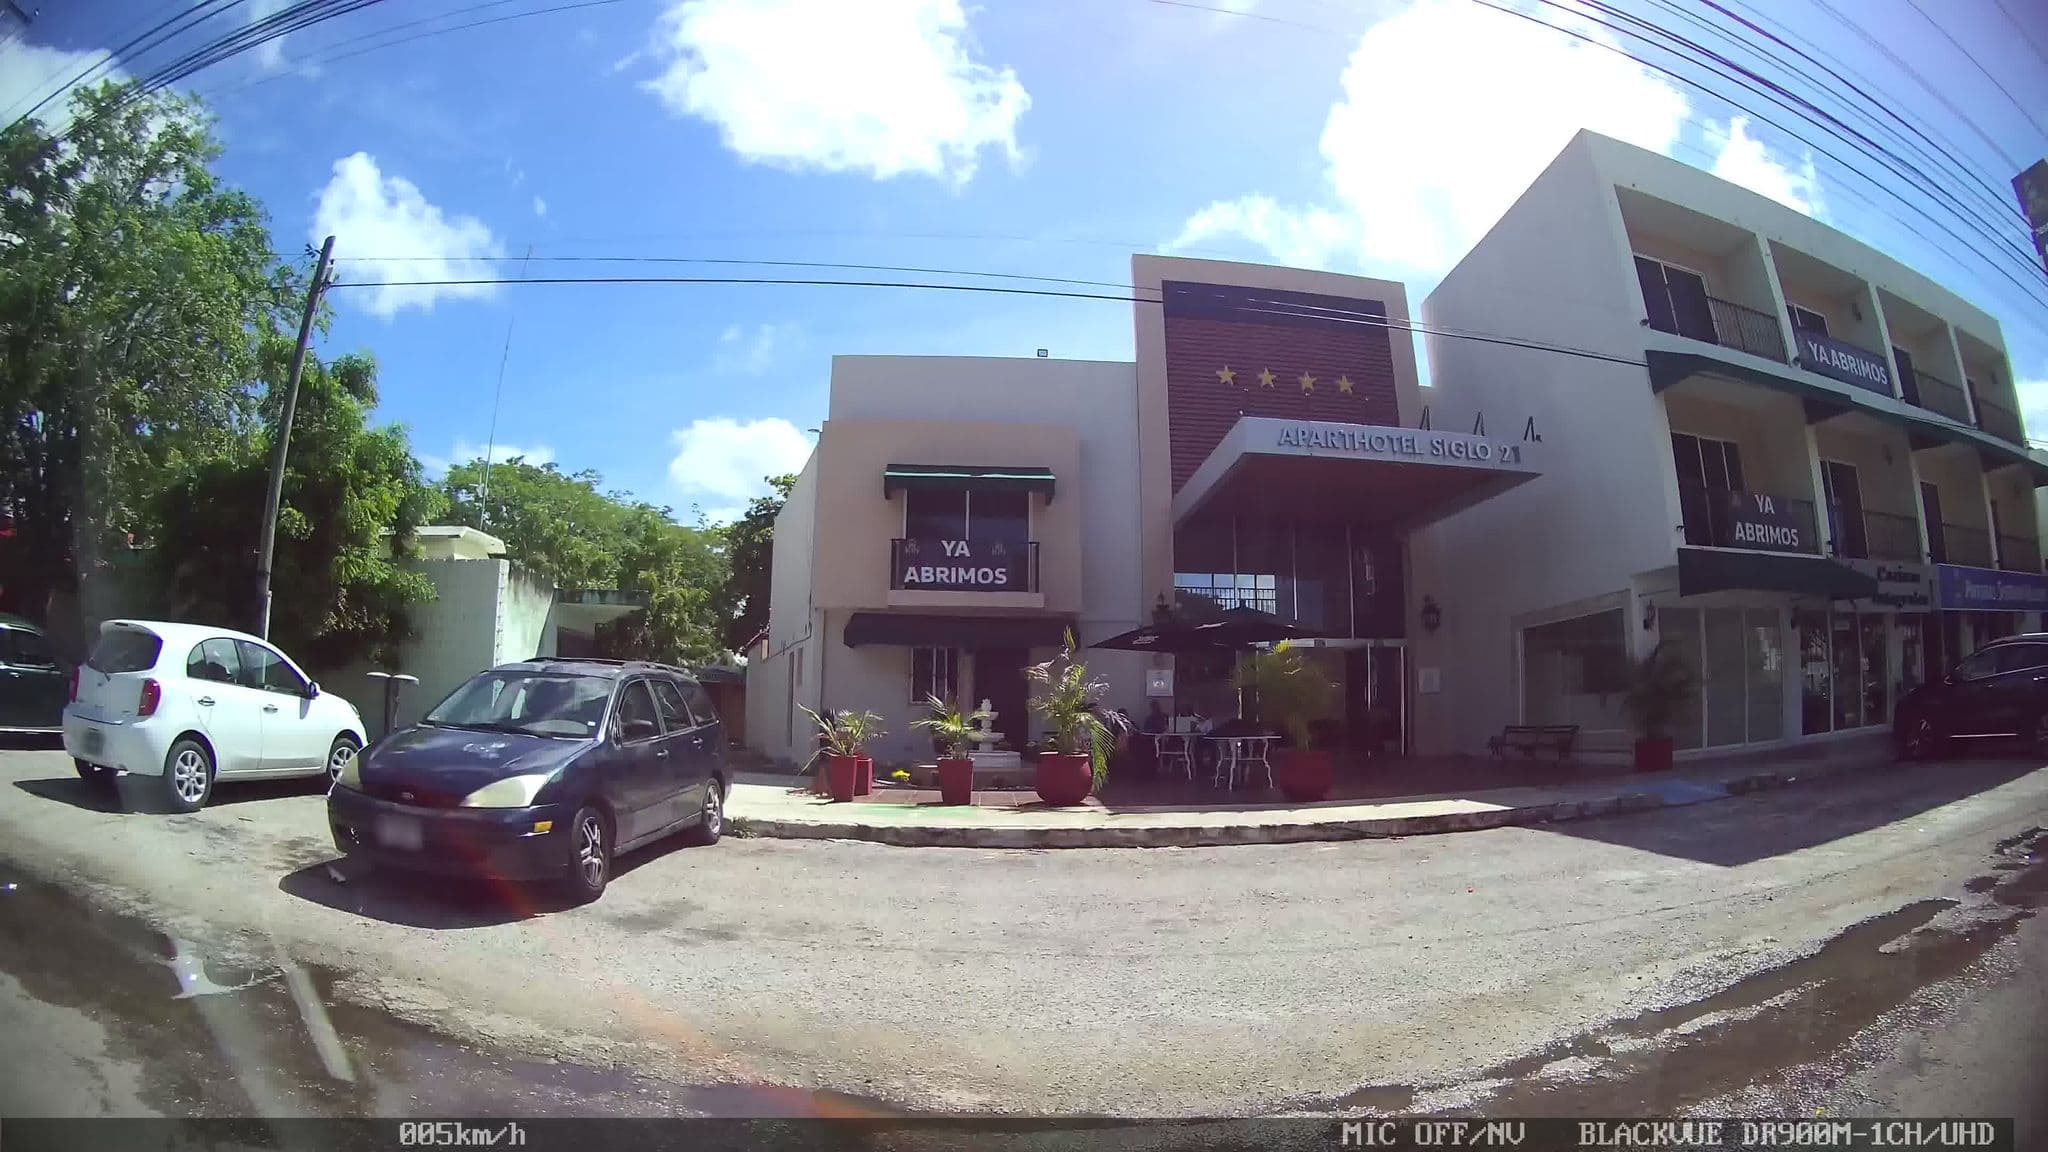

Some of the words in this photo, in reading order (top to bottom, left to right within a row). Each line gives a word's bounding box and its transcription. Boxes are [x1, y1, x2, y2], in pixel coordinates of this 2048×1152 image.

[1808, 342, 1831, 365] YA
[1831, 349, 1888, 385] ABRIMOS
[1279, 426, 1424, 455] APARTHOTEL
[1431, 438, 1492, 462] SIGLO
[1499, 445, 1521, 463] 21
[1755, 495, 1775, 514] YA
[1735, 521, 1799, 547] ABRIMOS
[941, 540, 971, 557] YA
[904, 566, 1007, 584] ABRIMOS
